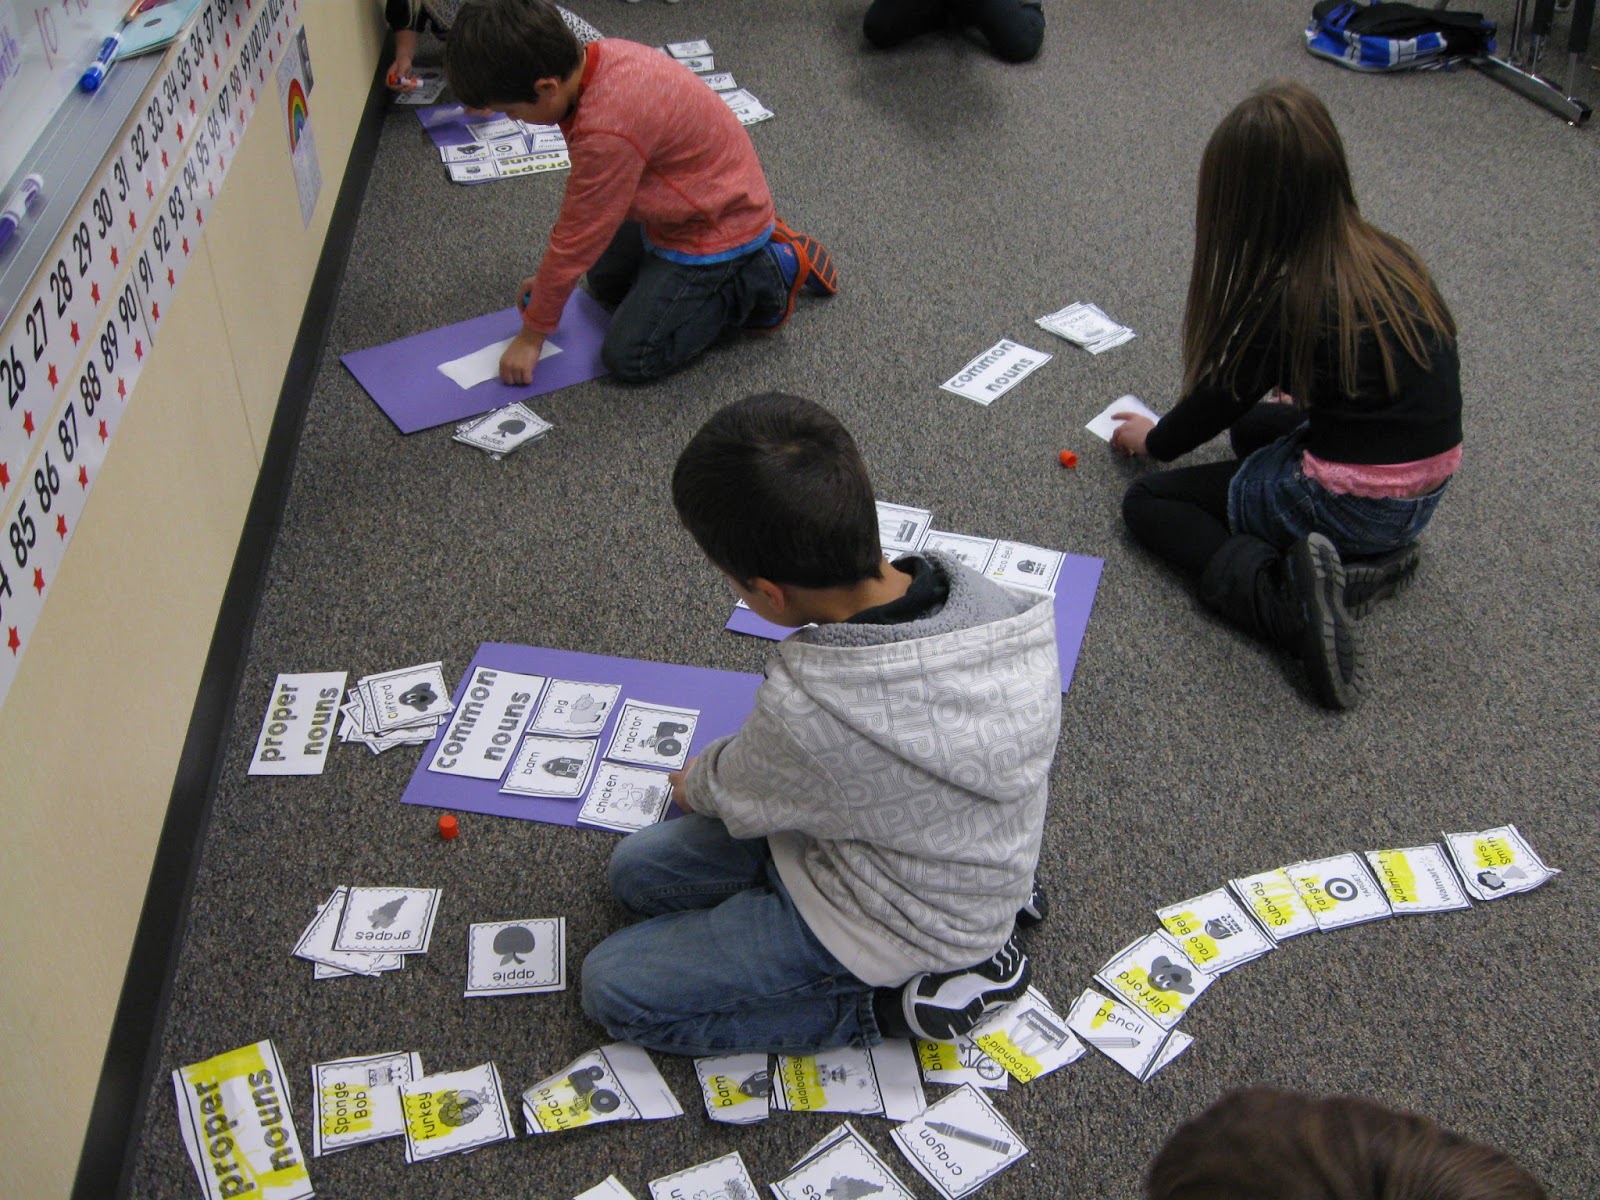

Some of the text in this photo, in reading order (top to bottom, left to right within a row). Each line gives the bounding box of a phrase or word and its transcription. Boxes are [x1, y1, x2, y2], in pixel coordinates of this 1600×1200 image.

[500, 153, 560, 165] nouns
[502, 160, 570, 175] proper
[0, 345, 26, 410] 26
[26, 298, 48, 363] 27
[50, 259, 73, 319] 28
[73, 221, 92, 277] 29
[93, 187, 113, 240] 30
[114, 156, 130, 202] 31
[131, 123, 149, 172] 32
[147, 96, 164, 143] 33
[163, 73, 178, 116] 34
[177, 47, 192, 91] 35
[190, 32, 204, 67] 36
[203, 5, 214, 44] 37
[10, 500, 36, 568] 85
[34, 451, 60, 513] 86
[58, 401, 79, 463] 87
[80, 361, 102, 417] 88
[100, 320, 119, 374] 89
[119, 284, 137, 335] 90
[139, 249, 154, 295] 91
[153, 215, 170, 263] 92
[169, 186, 185, 231] 93
[183, 160, 198, 201] 94
[195, 133, 210, 175] 95
[207, 108, 221, 144] 96
[219, 86, 231, 118] 97
[230, 65, 242, 95] 98
[241, 44, 251, 80] 99
[249, 24, 261, 63] 100
[260, 7, 271, 43] 101
[950, 341, 1016, 388] common
[986, 357, 1034, 392] nouns
[994, 559, 1008, 576] Taco
[260, 683, 298, 761] proper
[304, 688, 338, 755] nouns
[437, 670, 497, 769] common
[553, 699, 569, 715] pig
[484, 692, 531, 762] nouns
[622, 716, 643, 753] tractor
[521, 751, 540, 775] barn
[597, 774, 619, 813] chicken
[1487, 837, 1511, 865] Smith
[1300, 877, 1327, 913] Target
[1351, 873, 1372, 898] TARGET
[1378, 858, 1407, 904] Walmart
[1427, 867, 1451, 901] Walmart
[1251, 882, 1287, 927] Subway
[355, 930, 411, 940] grapes
[1171, 914, 1214, 963] Taco Bell
[493, 970, 535, 982] apple
[1118, 971, 1171, 1014] Clifford
[1095, 1006, 1144, 1036] pencil
[926, 1043, 942, 1072] bike
[982, 1033, 1036, 1080] McDonald's
[334, 1081, 349, 1135] Sponge
[354, 1091, 368, 1120] Bob
[715, 1075, 732, 1107] barn
[248, 1068, 297, 1172] nouns
[424, 1091, 435, 1140] turkey
[194, 1082, 255, 1199] proper
[919, 1129, 963, 1176] crayon
